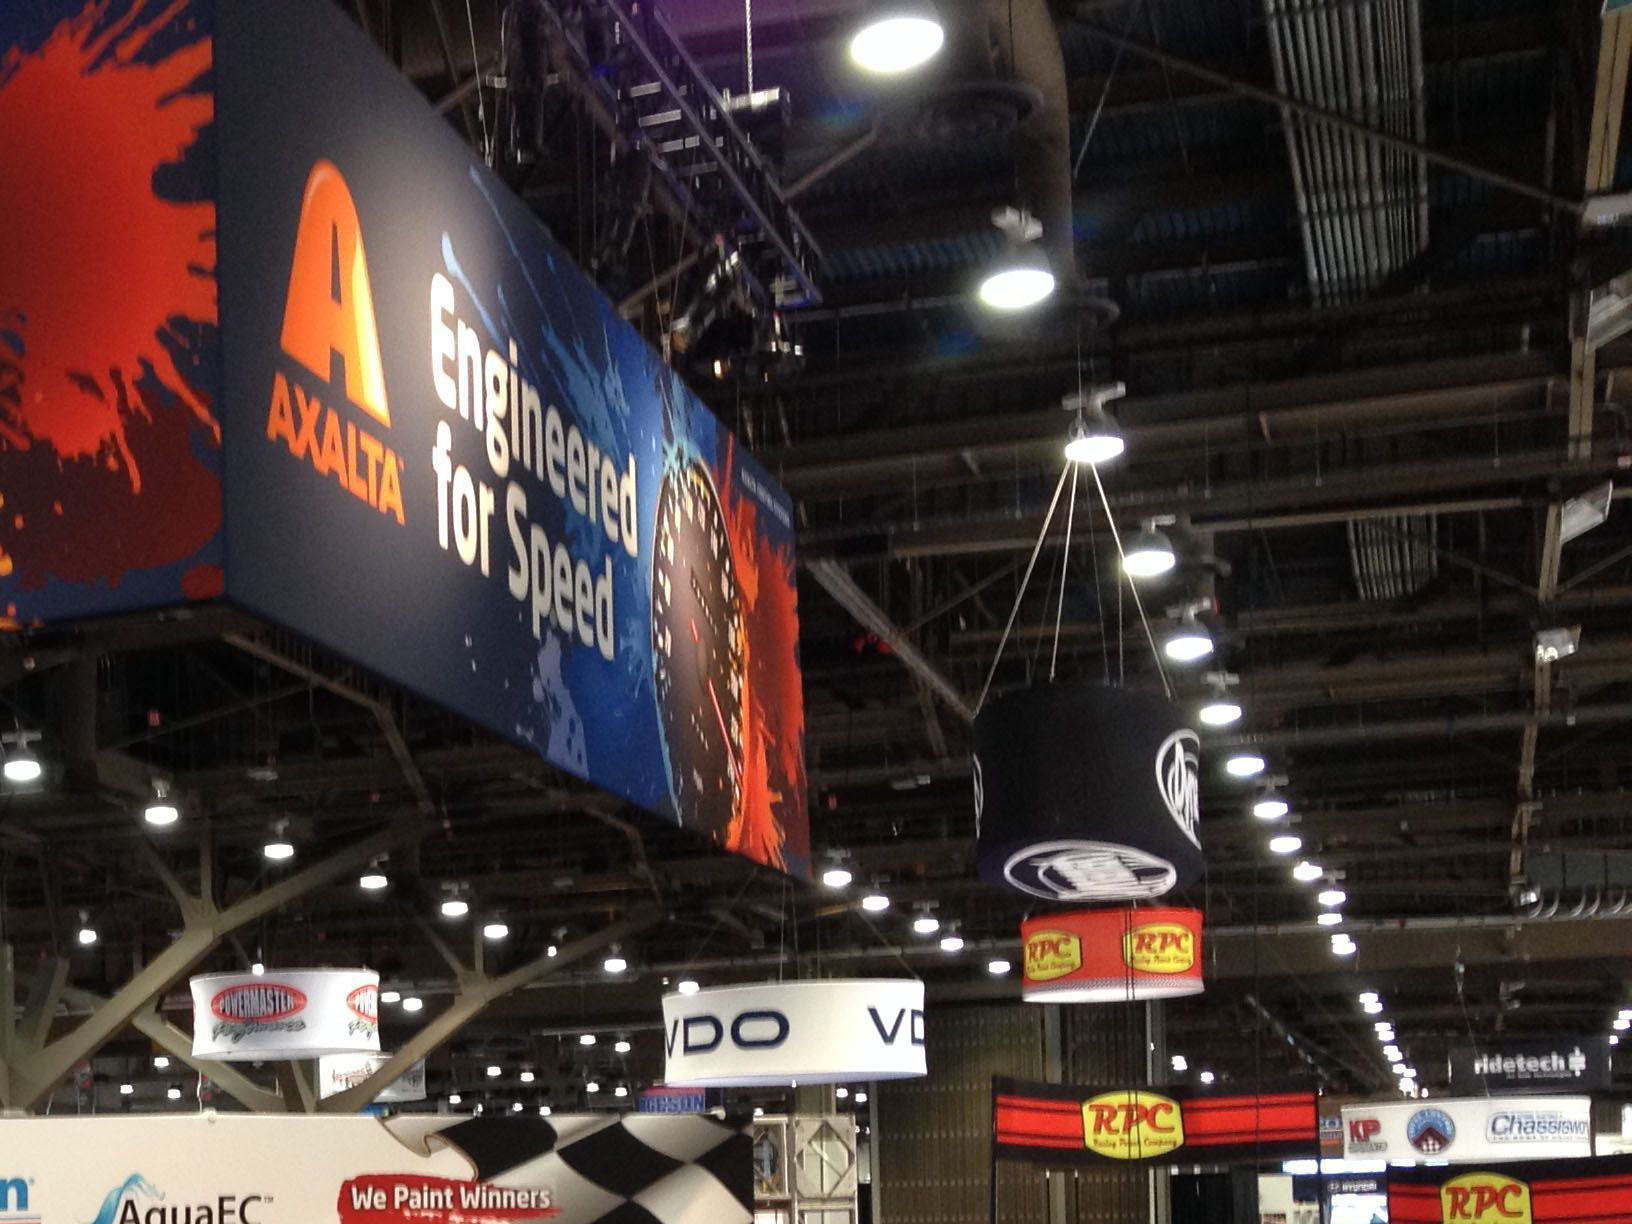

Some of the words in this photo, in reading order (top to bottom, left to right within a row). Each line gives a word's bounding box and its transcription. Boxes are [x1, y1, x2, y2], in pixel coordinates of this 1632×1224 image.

[430, 271, 638, 558] Engineered
[268, 372, 405, 525] AXALTA
[432, 421, 495, 577] for
[506, 483, 616, 661] Speed
[1027, 936, 1071, 962] RPC
[1133, 932, 1190, 954] RPC
[219, 987, 296, 1018] POWERMASTER
[665, 1009, 790, 1058] VDO
[1474, 1051, 1565, 1075] ridetech
[1089, 1103, 1175, 1135] RPC
[351, 1186, 386, 1210] We
[394, 1184, 454, 1210] Paint
[459, 1185, 551, 1210] Winners
[1445, 1184, 1523, 1219] RPC
